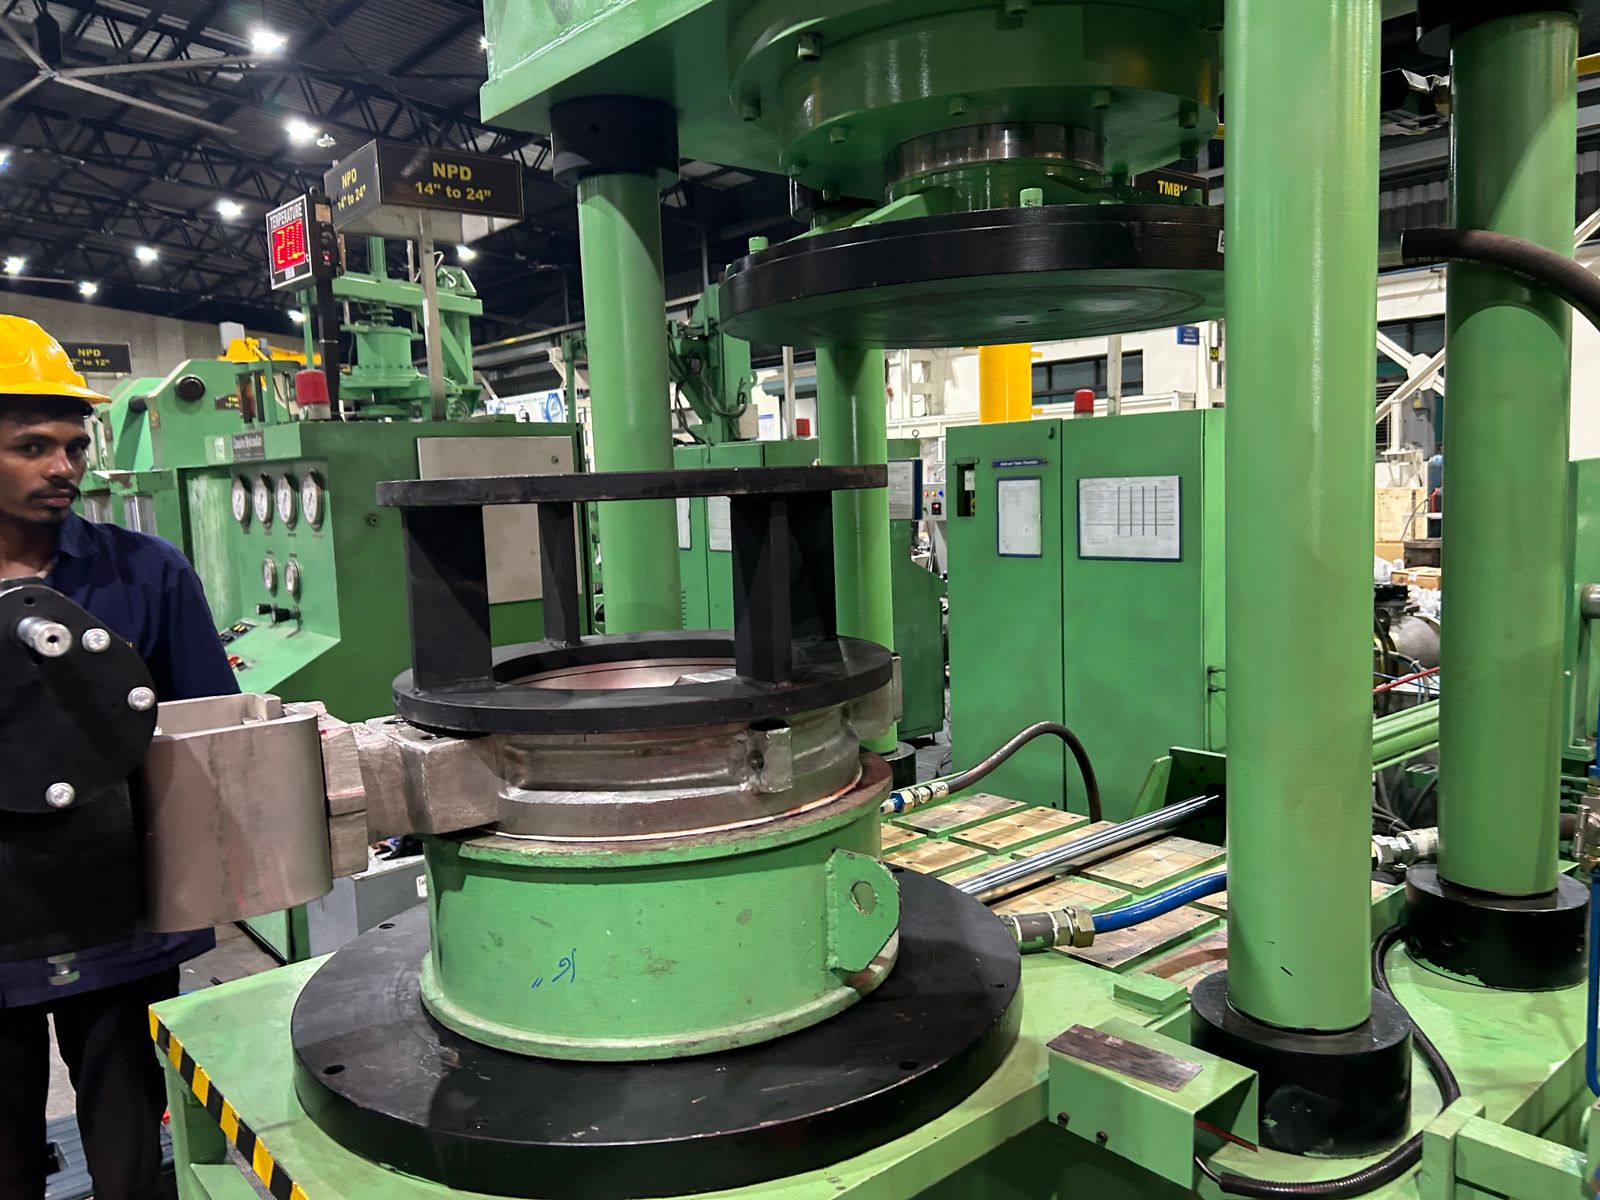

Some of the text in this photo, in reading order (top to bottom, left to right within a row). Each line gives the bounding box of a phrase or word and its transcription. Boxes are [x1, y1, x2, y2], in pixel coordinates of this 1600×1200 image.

[341, 168, 357, 190] NPD
[431, 161, 472, 181] NPD
[347, 194, 355, 206] to
[355, 184, 366, 202] 24"
[415, 181, 492, 202] 14" to 24"
[269, 202, 303, 229] TEMPERATURE
[77, 348, 101, 358] NPD
[82, 358, 93, 366] to
[95, 358, 110, 367] 12"
